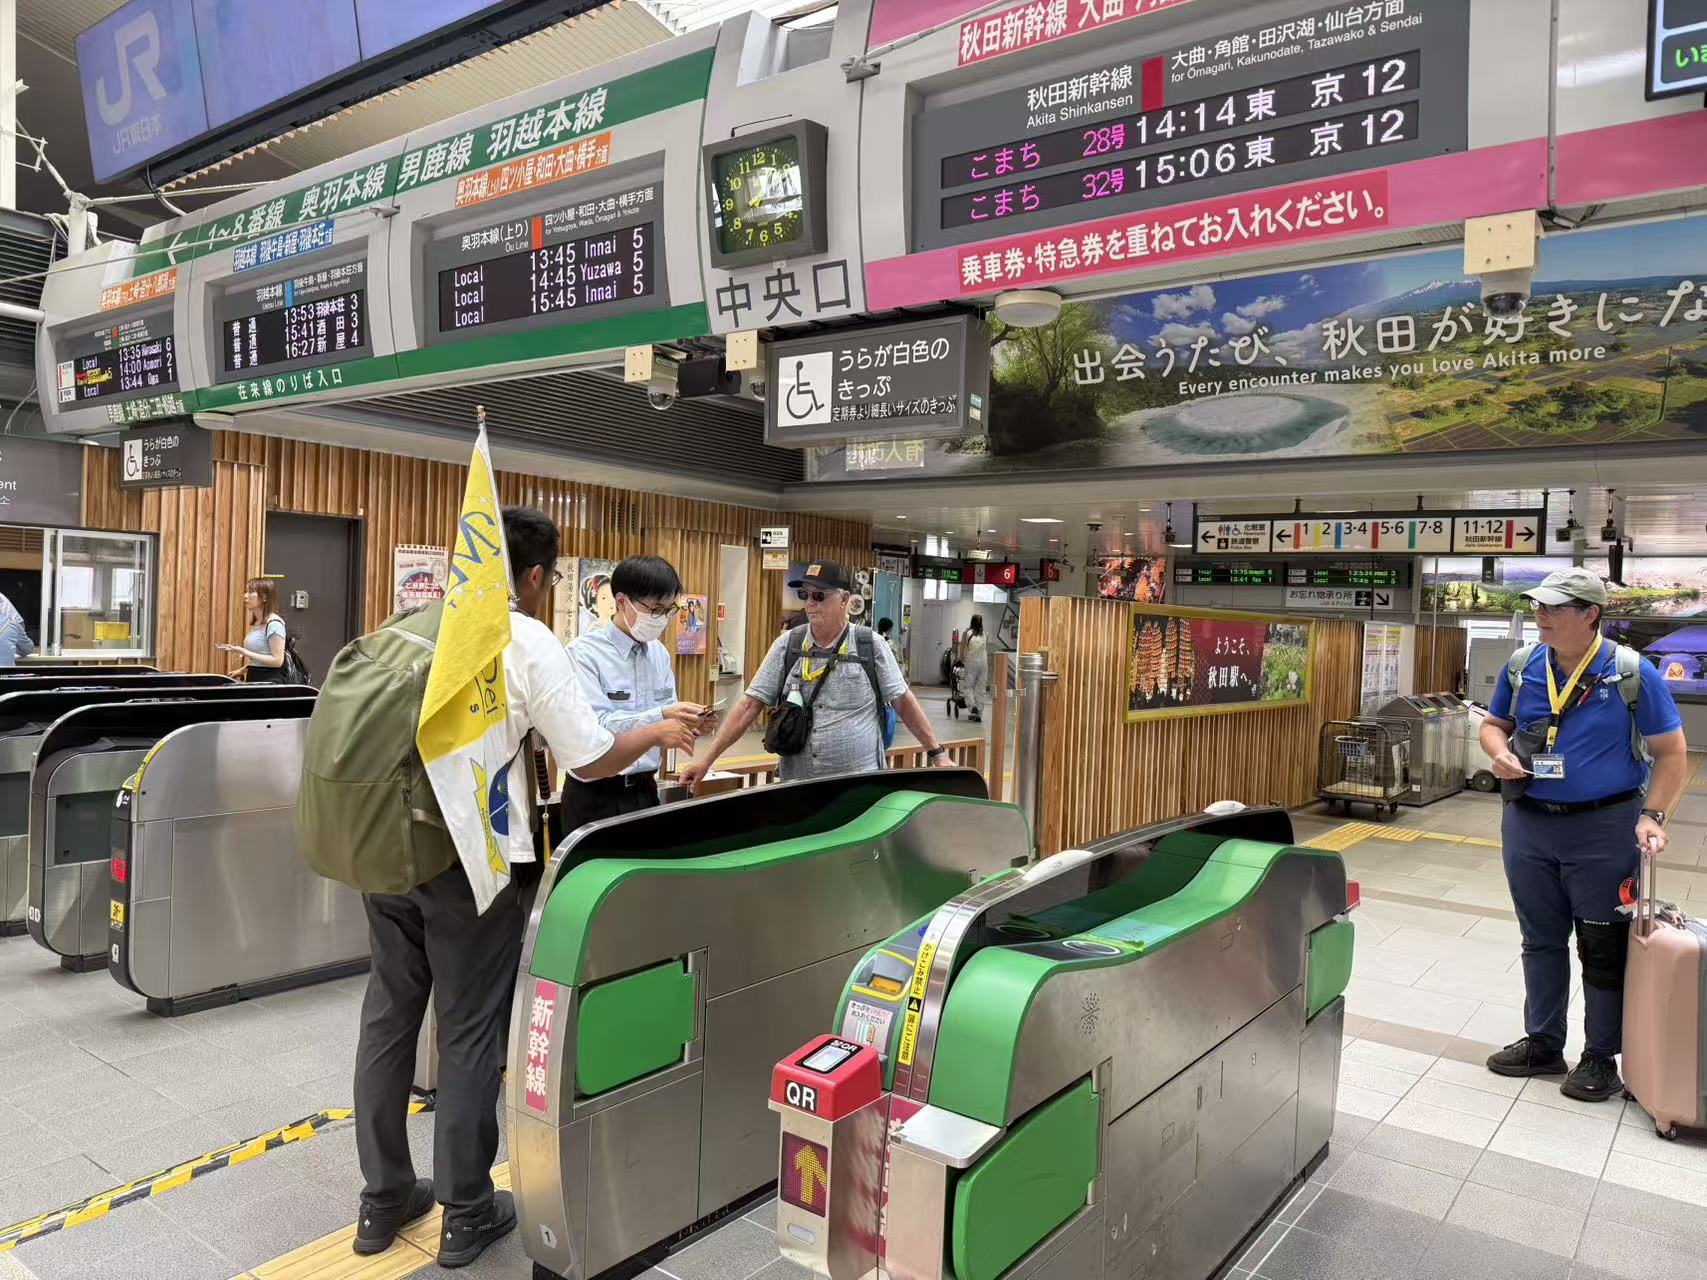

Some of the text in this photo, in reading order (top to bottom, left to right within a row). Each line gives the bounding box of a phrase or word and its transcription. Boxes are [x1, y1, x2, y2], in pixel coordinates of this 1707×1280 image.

[961, 0, 1068, 62] 秋田新幹線
[1171, 71, 1185, 84] for
[1237, 43, 1304, 67] Kakunodate,
[1307, 26, 1364, 49] Tazawako
[1368, 24, 1377, 36] &
[1380, 13, 1423, 33] Sendai
[95, 10, 167, 126] JR
[1027, 64, 1133, 111] 秋田新幹線
[971, 142, 1041, 179] こまち
[1083, 123, 1125, 157] 28号
[1136, 96, 1236, 144] 14:14
[1362, 59, 1406, 96] 12
[1026, 95, 1133, 129] Akita Shinkansen
[112, 111, 162, 155] JR東日本
[299, 162, 388, 222] 奥羽本線
[397, 133, 475, 190] 男鹿線
[487, 88, 608, 161] 羽越本線
[739, 161, 751, 174] 11
[752, 152, 766, 166] 12
[771, 154, 777, 166] 1
[970, 183, 1040, 220] こまち
[1082, 167, 1125, 200] 32号
[1135, 143, 1236, 188] 15:06
[1361, 108, 1404, 145] 12
[729, 178, 742, 191] 10
[725, 199, 734, 210] 9
[733, 218, 742, 230] 8
[745, 229, 754, 241] 7
[760, 230, 769, 242] 6
[774, 222, 783, 235] 5
[455, 227, 643, 288] Local 13:45 Innai 5
[516, 240, 529, 250] Line
[455, 250, 644, 308] Local 14:45 Yuzawa 5
[716, 259, 852, 328] 中央口
[285, 303, 315, 324] 13:53
[350, 293, 358, 310] 3
[455, 274, 644, 327] Local 15:45 Innai 5
[285, 321, 315, 342] 15:41
[350, 311, 358, 328] 3
[82, 356, 98, 370] Local
[119, 344, 141, 362] 13:35
[165, 337, 172, 351] 6
[285, 338, 315, 359] 16:27
[351, 329, 359, 345] 4
[838, 338, 950, 372] うらが白色の
[1073, 325, 1288, 386] 出会うたび、
[119, 359, 141, 376] 14:00
[166, 352, 172, 366] 2
[1178, 344, 1606, 396] Every encounter makes you love Akita more
[84, 384, 99, 398] Local
[120, 374, 143, 390] 13:44
[168, 368, 173, 381] 1
[237, 368, 343, 400] 在来線のりば入口
[836, 376, 891, 401] きっぷ
[1303, 523, 1309, 534] 1
[1322, 522, 1332, 535] 2
[1004, 568, 1011, 579] 6
[1214, 636, 1250, 656] ようこそ、
[525, 995, 554, 1097] 新幹線
[840, 1041, 859, 1052] QR
[786, 1081, 817, 1111] QR
